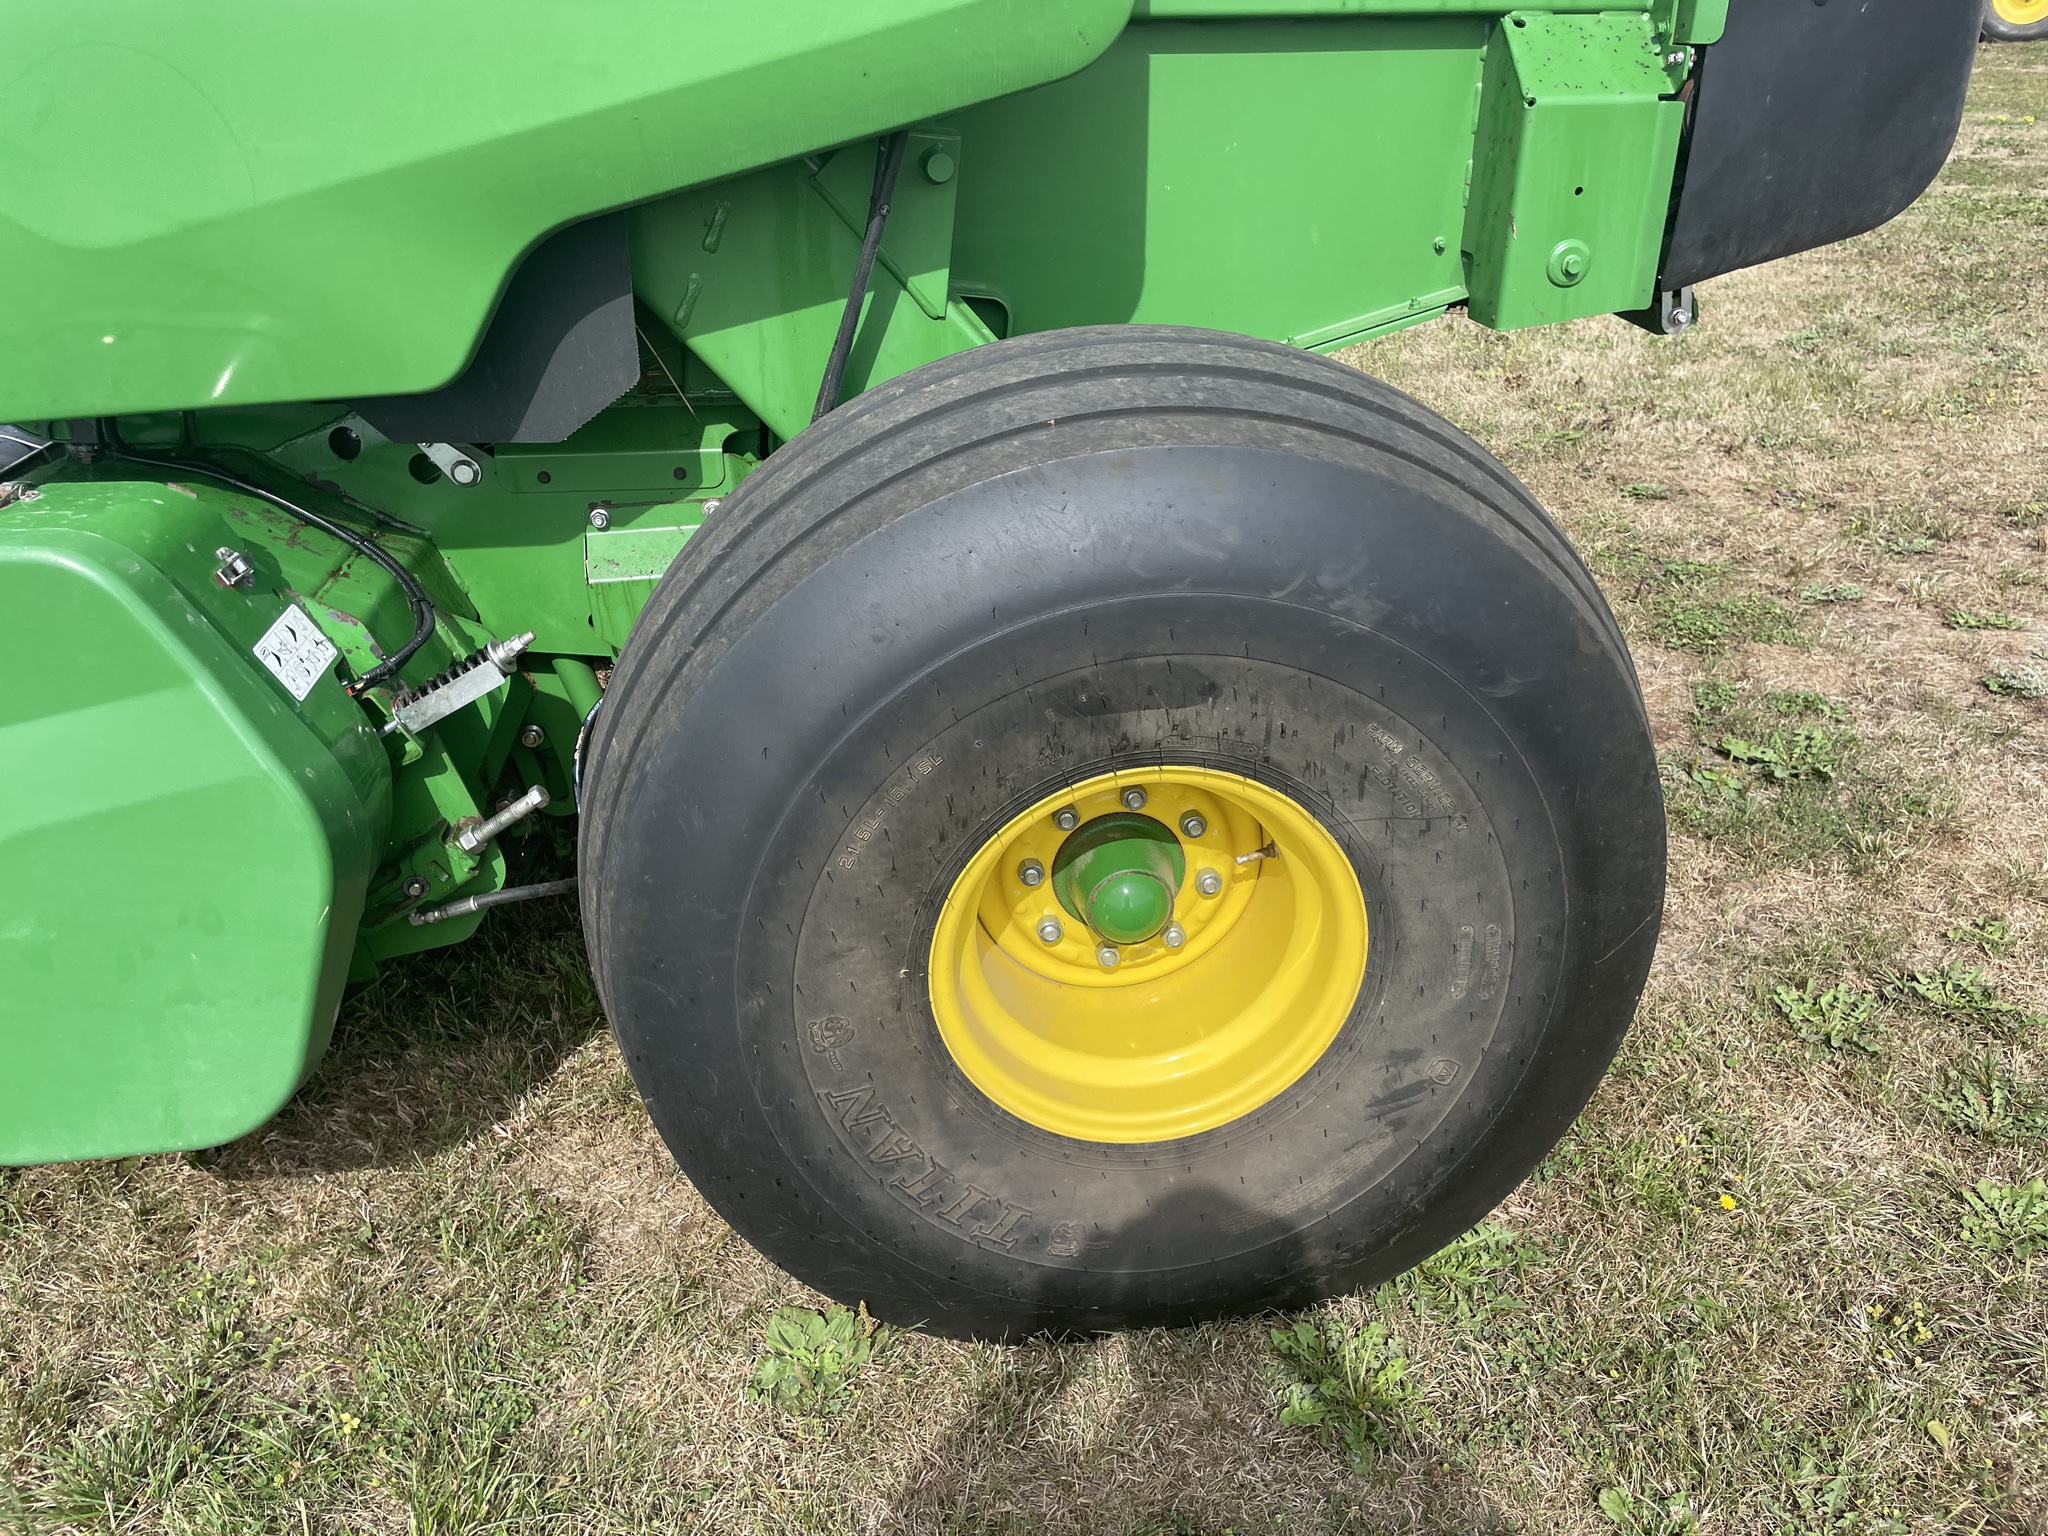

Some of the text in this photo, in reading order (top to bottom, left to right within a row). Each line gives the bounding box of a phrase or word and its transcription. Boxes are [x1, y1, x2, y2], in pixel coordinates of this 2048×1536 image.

[1364, 724, 1404, 755] FARM
[1405, 756, 1456, 812] SERVICE
[1369, 766, 1422, 818] FLOTATION
[823, 1084, 1033, 1250] TITAN
